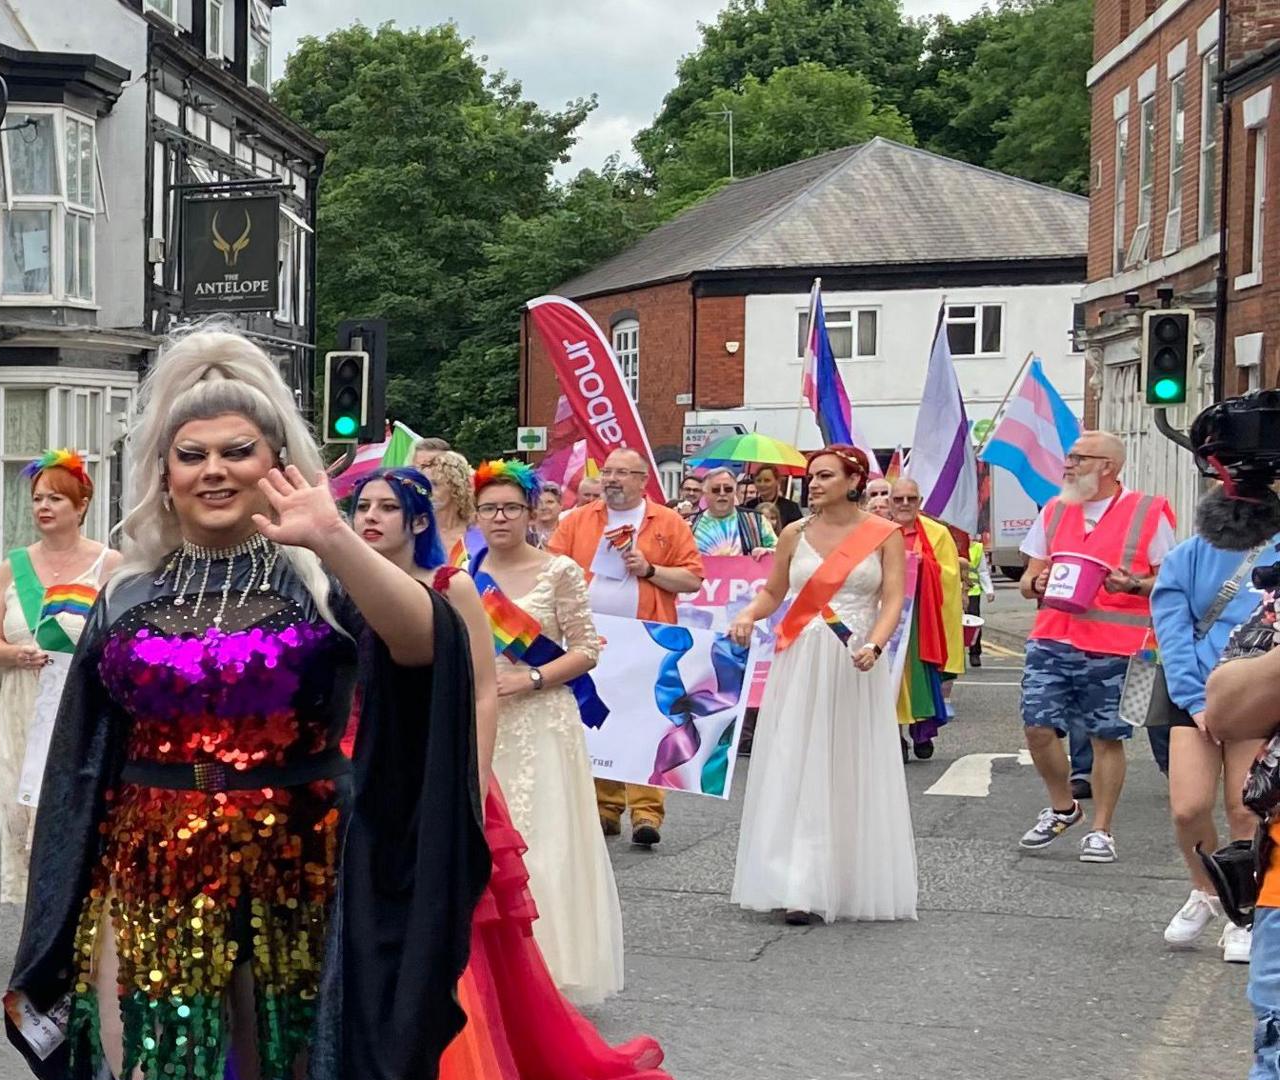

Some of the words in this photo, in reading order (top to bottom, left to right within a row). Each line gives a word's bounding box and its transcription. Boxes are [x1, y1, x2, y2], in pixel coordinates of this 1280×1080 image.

[223, 273, 239, 281] THE
[194, 279, 270, 295] ANTELOPE
[562, 339, 628, 448] abour
[590, 755, 614, 768] rust
